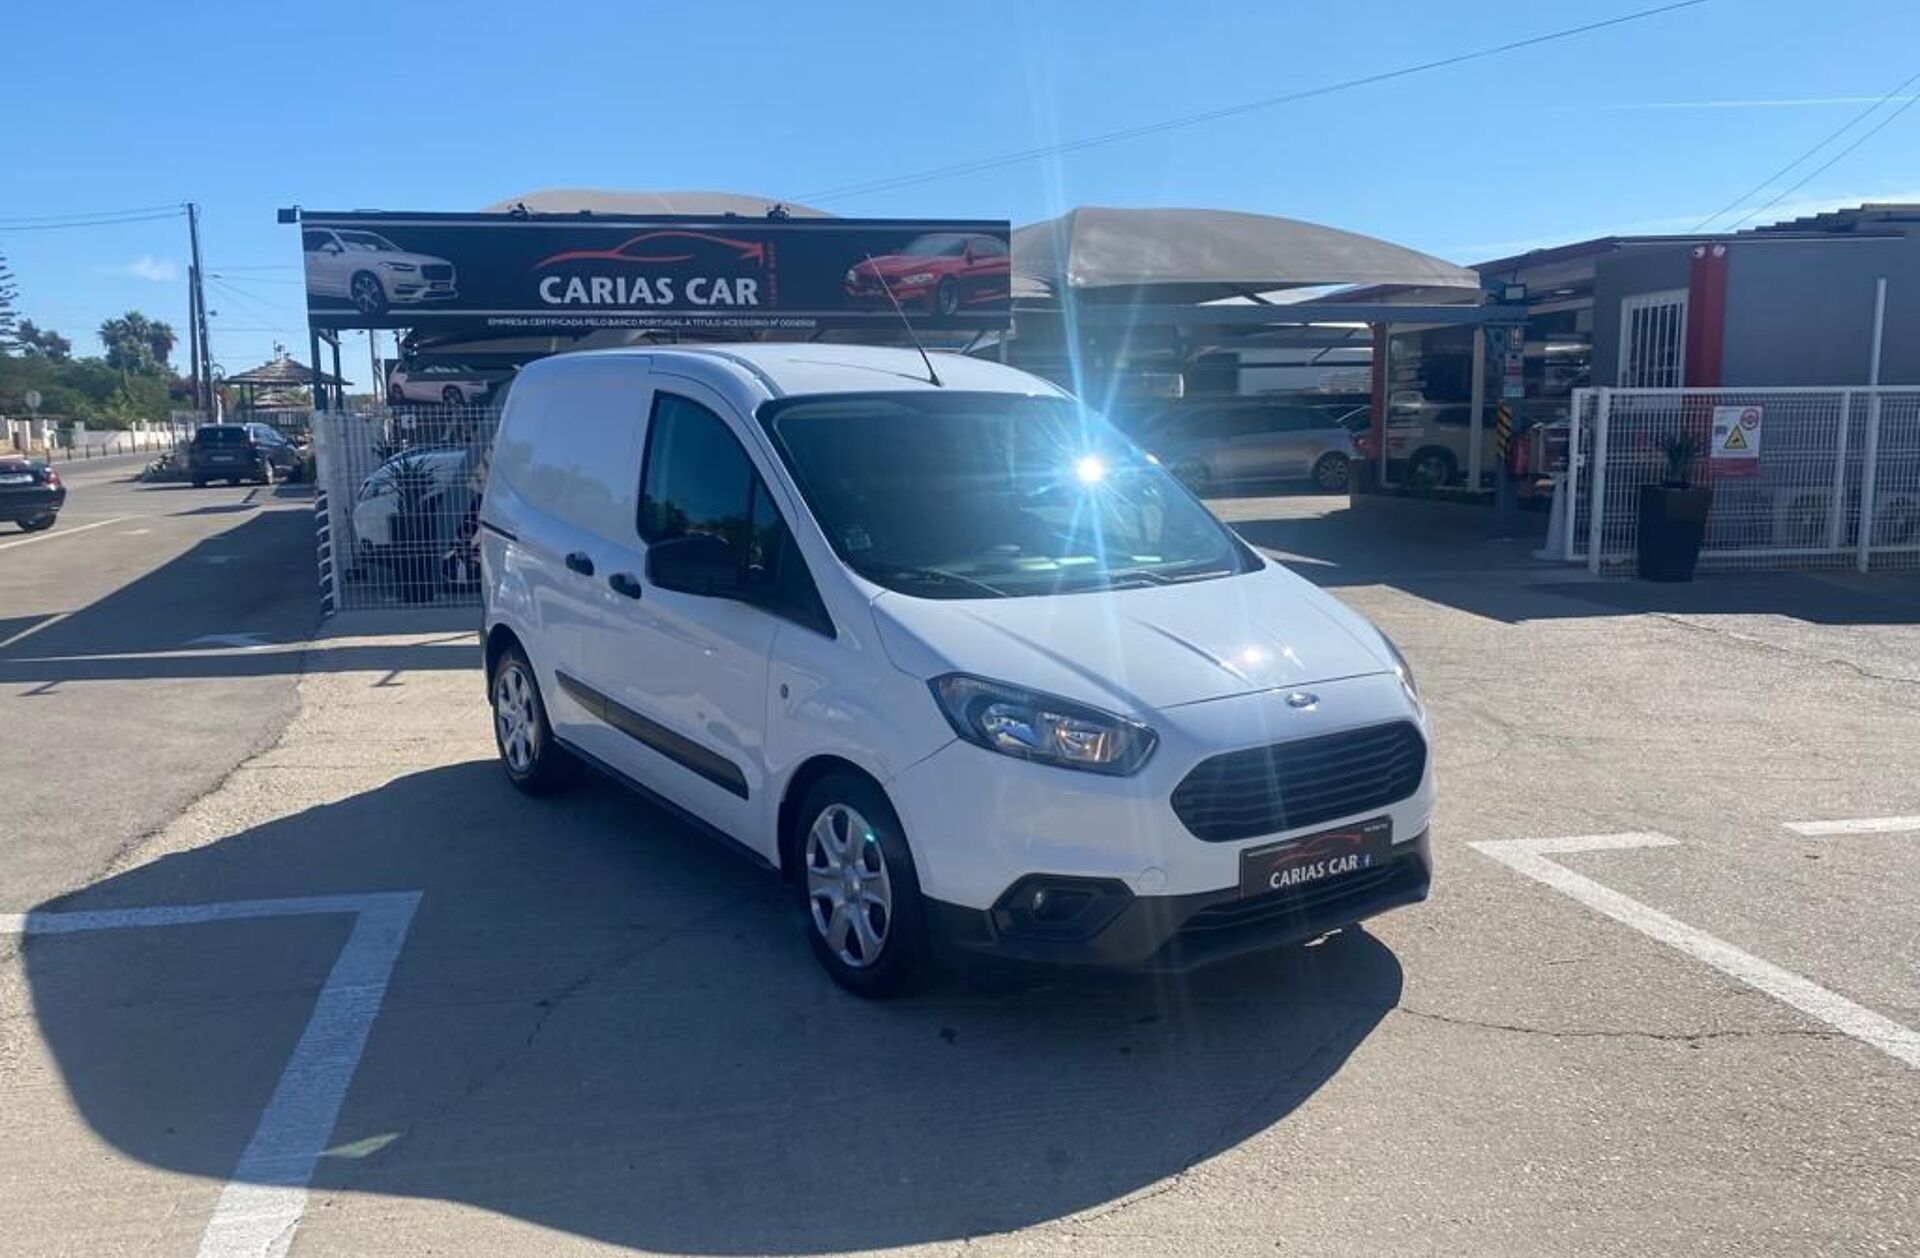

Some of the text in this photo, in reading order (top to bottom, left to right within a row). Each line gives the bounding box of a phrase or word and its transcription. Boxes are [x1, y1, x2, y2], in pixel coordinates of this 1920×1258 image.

[539, 276, 760, 306] CARIAS CAR
[1270, 861, 1325, 889] CARIAS
[1328, 854, 1359, 875] CAR
